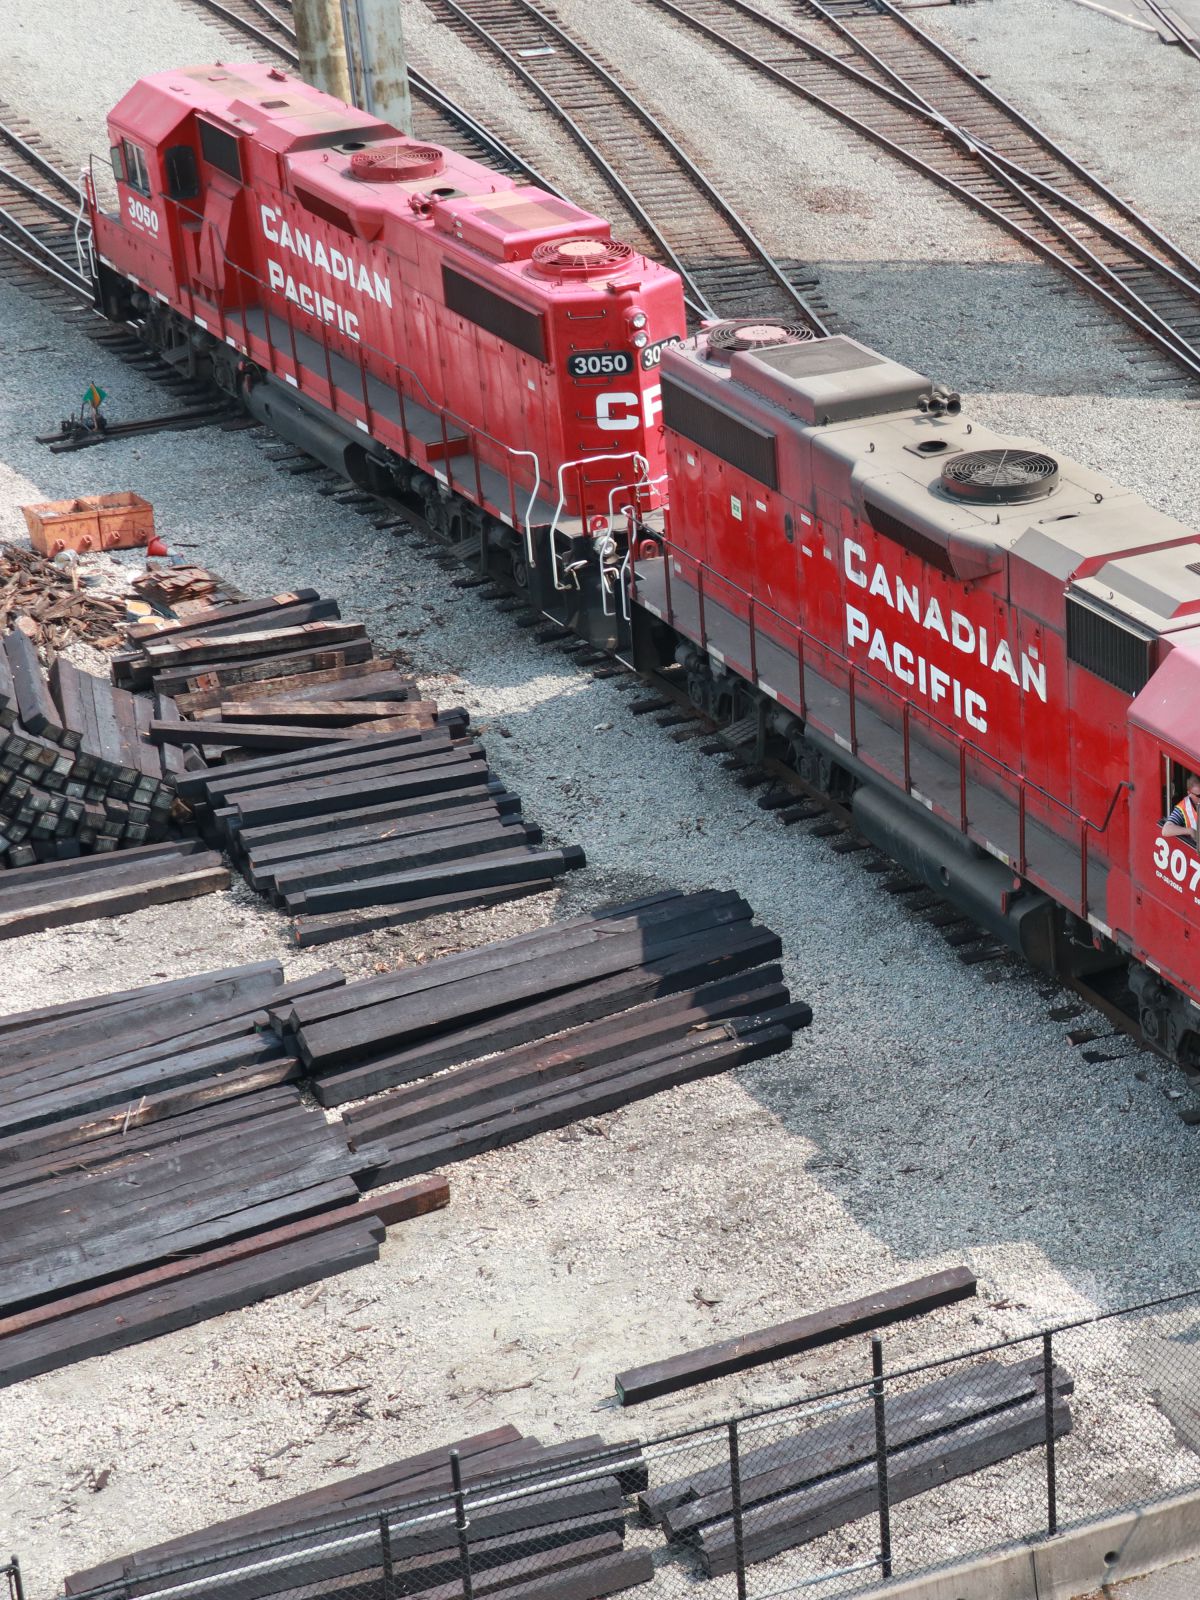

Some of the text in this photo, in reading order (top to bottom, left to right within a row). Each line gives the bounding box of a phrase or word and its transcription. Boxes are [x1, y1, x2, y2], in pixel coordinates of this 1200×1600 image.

[128, 196, 159, 233] 3050
[261, 204, 393, 309] CANADIAN
[268, 258, 361, 343] PACIFIC
[574, 354, 628, 375] 3050
[844, 537, 1047, 704] CANADIAN
[846, 602, 987, 734] PACIFIC
